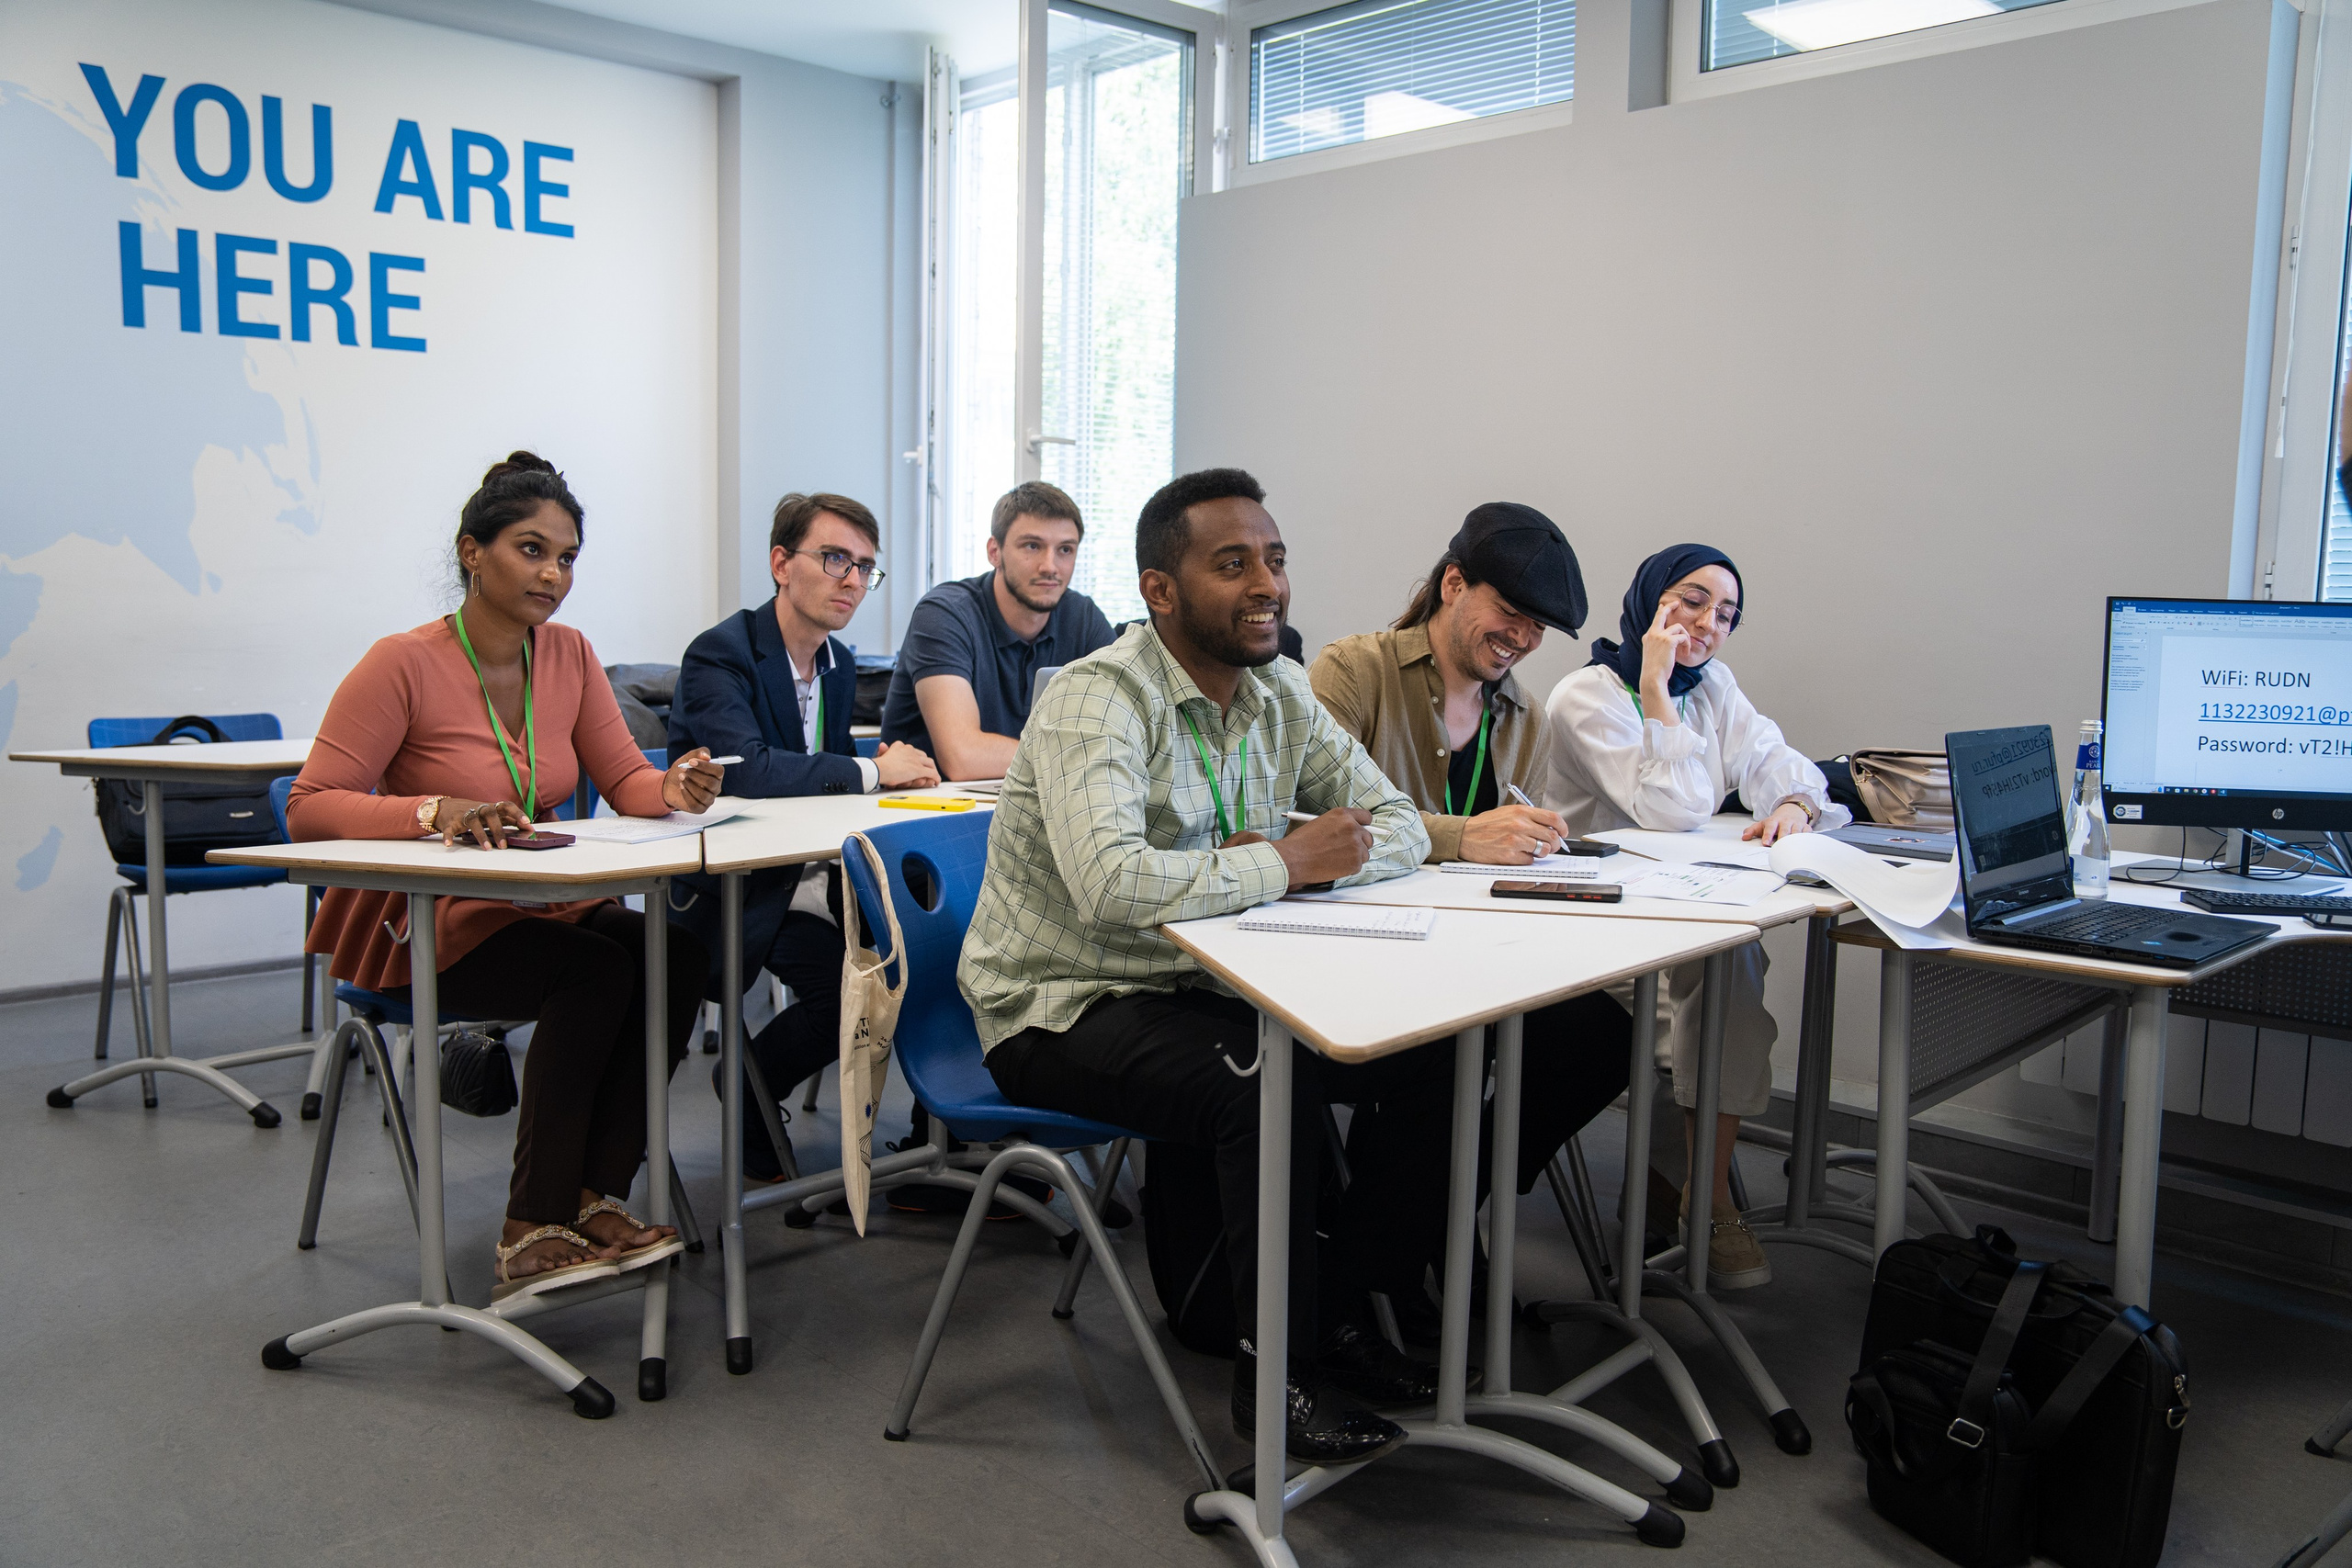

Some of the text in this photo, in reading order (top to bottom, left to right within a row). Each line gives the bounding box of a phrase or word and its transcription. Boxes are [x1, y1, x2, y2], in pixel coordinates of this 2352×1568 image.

[78, 62, 574, 239] YOU ARE
[119, 220, 427, 353] HERE
[2200, 669, 2311, 688] WiFi: RUDN
[2199, 702, 2352, 726] 1132230921@p
[2198, 735, 2293, 754] Password:
